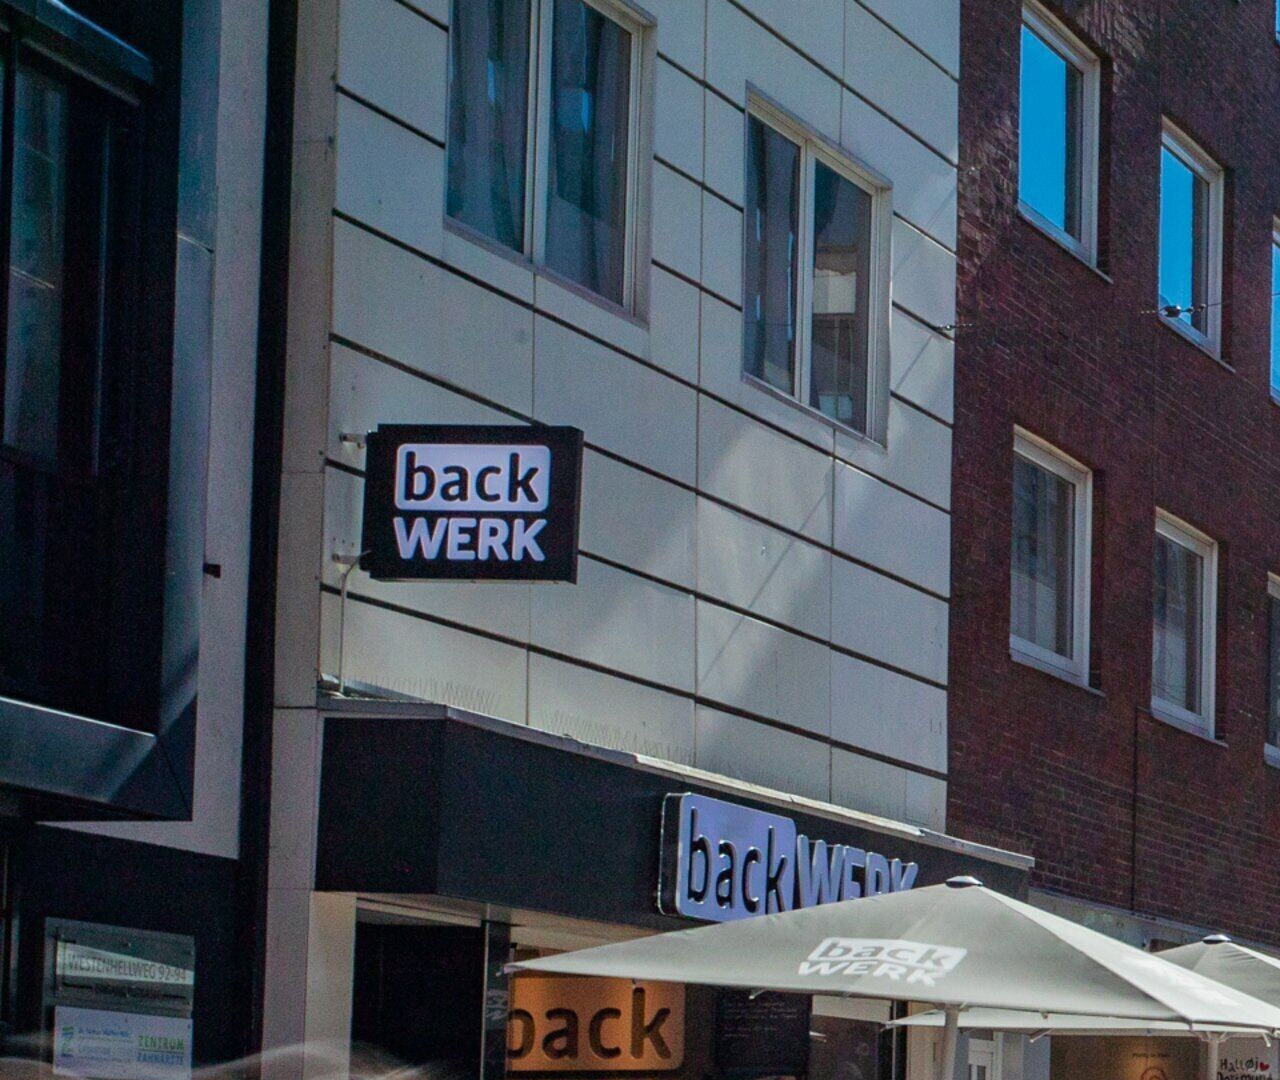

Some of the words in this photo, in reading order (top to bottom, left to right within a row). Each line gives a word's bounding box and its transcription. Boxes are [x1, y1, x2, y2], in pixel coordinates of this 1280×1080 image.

[404, 449, 540, 503] back
[393, 515, 548, 562] WERK
[688, 806, 789, 916] back
[798, 961, 949, 988] WERK
[820, 943, 952, 971] back
